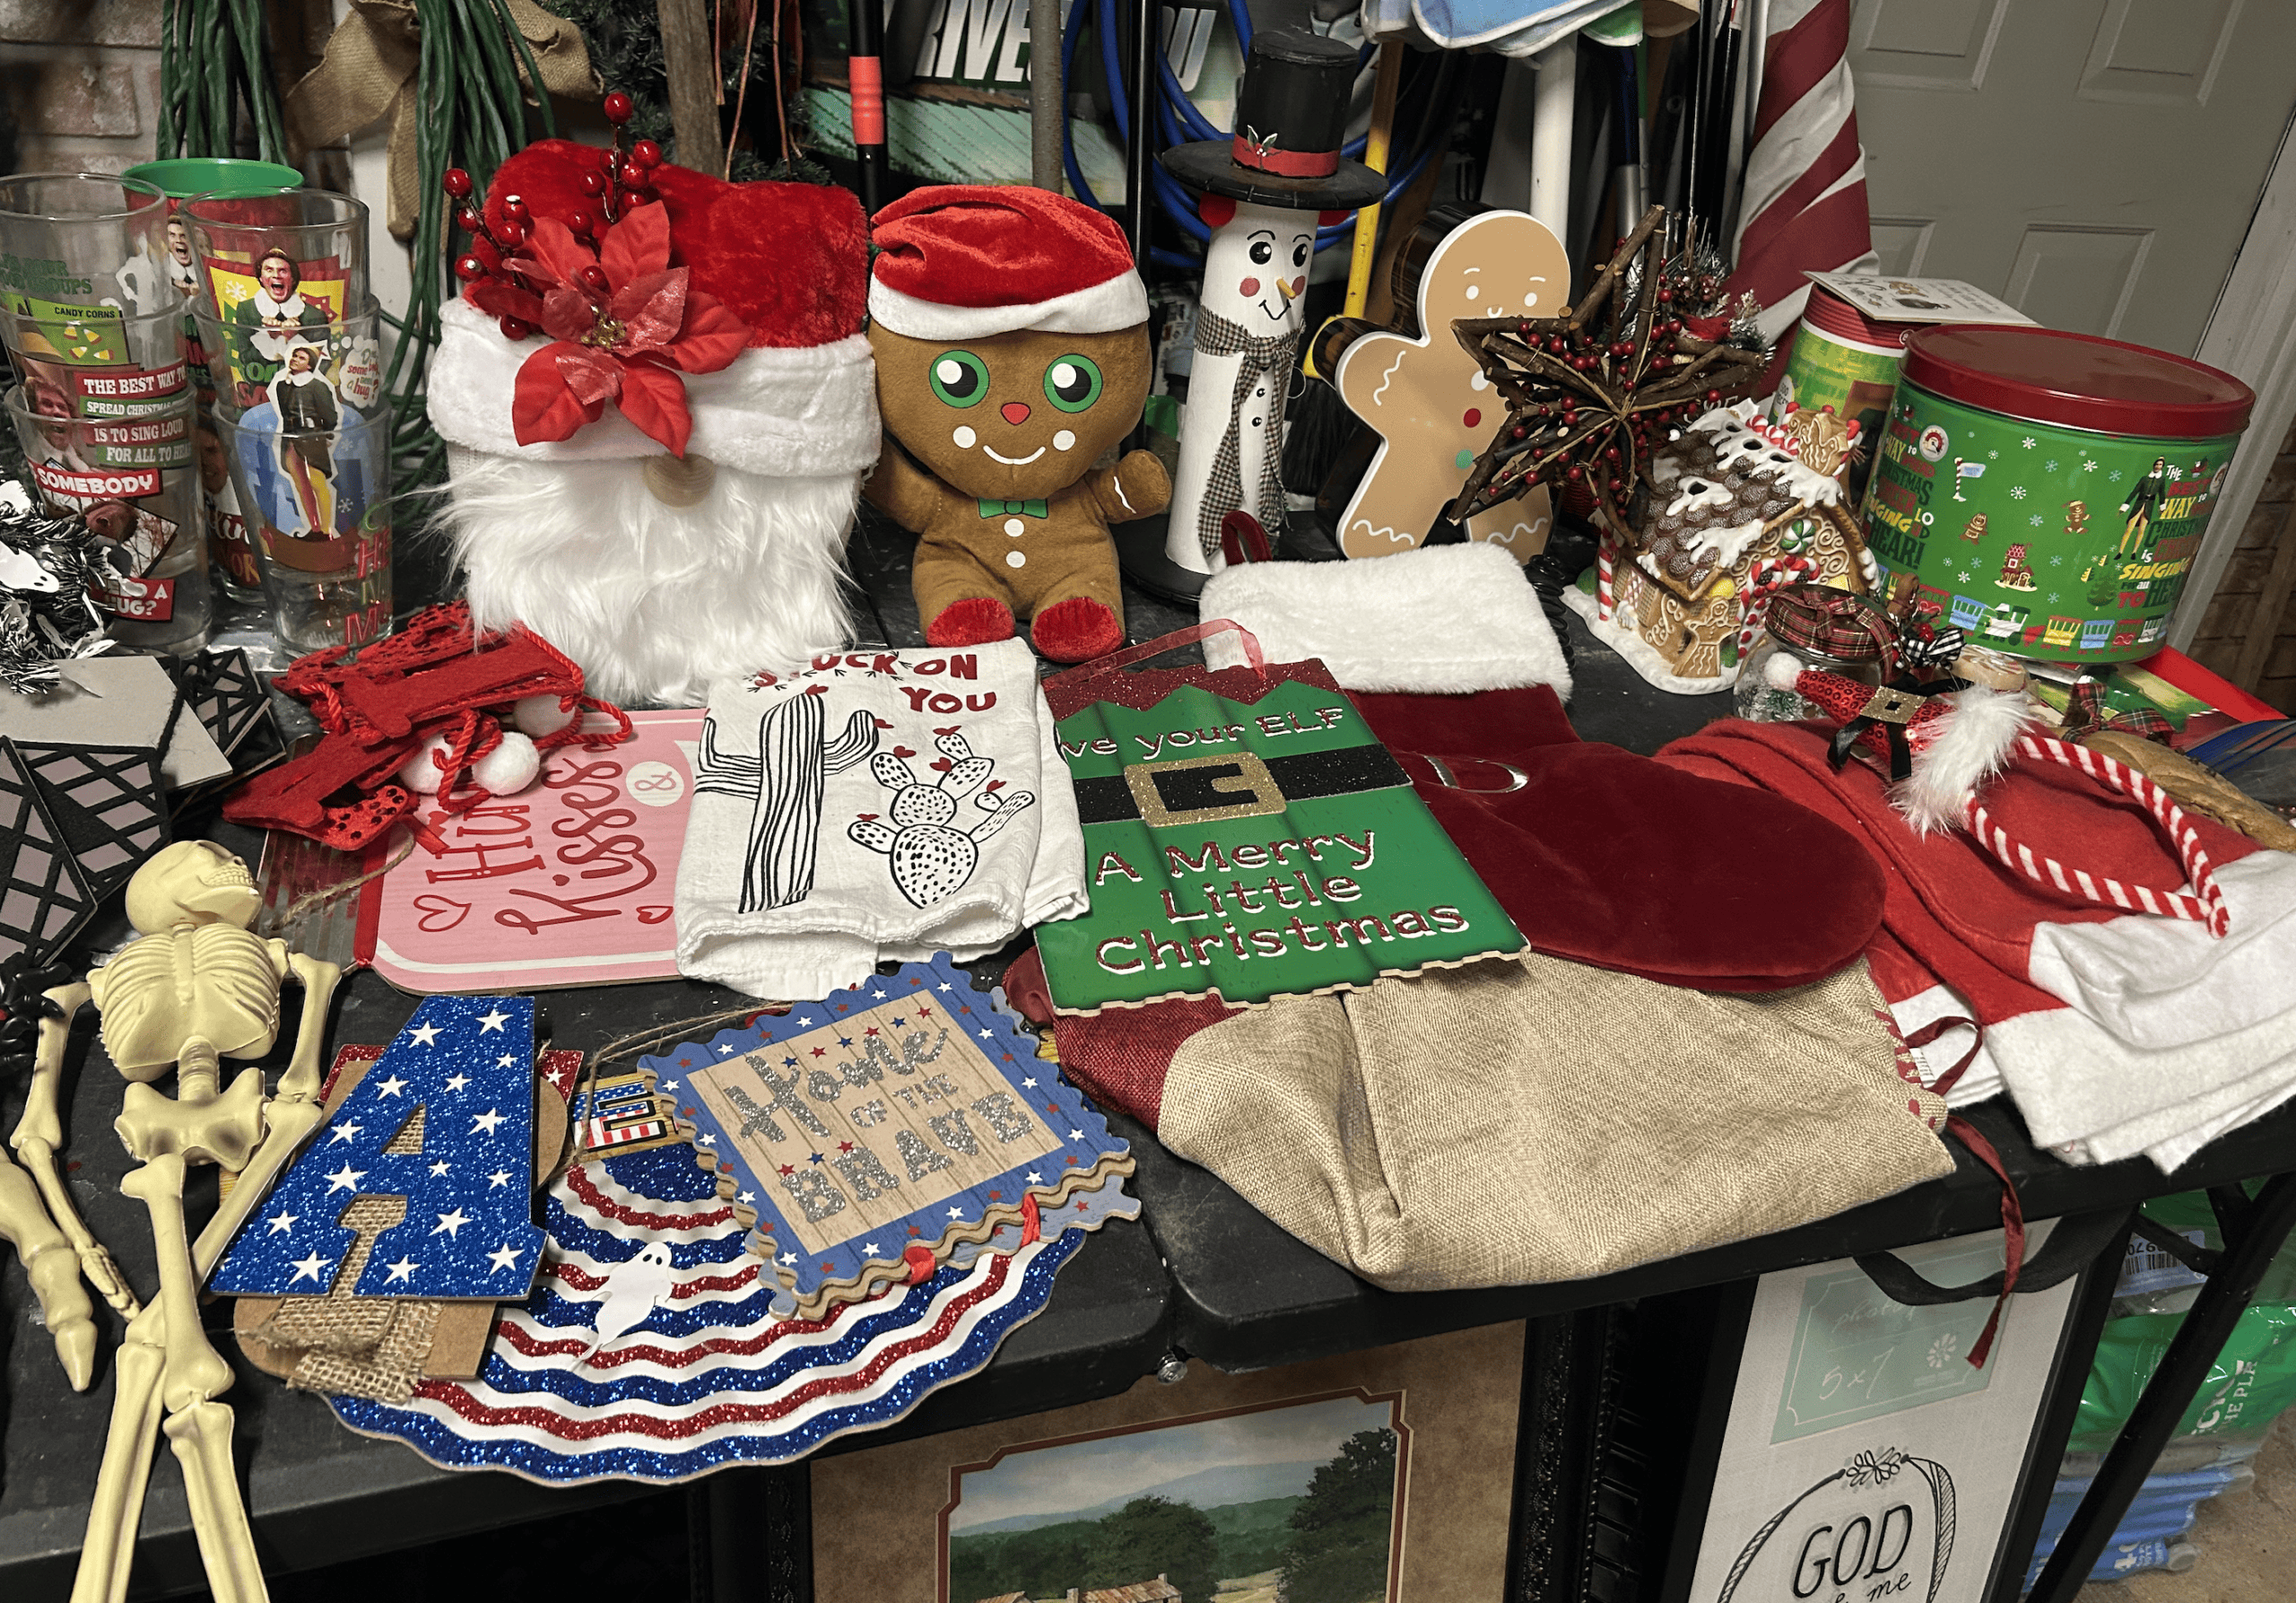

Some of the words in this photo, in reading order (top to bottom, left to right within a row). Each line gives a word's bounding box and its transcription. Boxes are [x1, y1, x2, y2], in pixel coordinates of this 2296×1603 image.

[55, 306, 83, 318] CANDY
[86, 309, 116, 318] CORNS
[83, 378, 117, 395] THE
[119, 376, 154, 394] BEST
[157, 368, 176, 389] WAY
[86, 401, 126, 415] SPREAD
[94, 428, 108, 442] IS
[109, 428, 128, 442] TO
[131, 425, 160, 442] SING
[161, 418, 184, 438] LOUD
[106, 447, 132, 463] FOR
[134, 448, 156, 463] ALL
[158, 446, 172, 462] TO
[1907, 445, 1918, 455] to
[37, 467, 153, 493] SOMEBODY
[2166, 465, 2183, 482] THE
[2159, 496, 2196, 520] WAY
[153, 583, 169, 600] A
[2117, 590, 2146, 609] TO
[913, 653, 978, 680] ON
[899, 685, 997, 713] YOU
[1135, 720, 1247, 761] your
[1255, 706, 1344, 738] ELF
[1094, 851, 1144, 886] A
[1164, 829, 1376, 879] Merry
[1159, 870, 1363, 926] Little
[1094, 904, 1471, 975] Christmas
[725, 1026, 949, 1144] Home
[850, 1097, 889, 1128] OF
[891, 1073, 960, 1111] THE
[779, 1090, 1035, 1224] BRAVE
[1792, 1503, 1913, 1599] GOD
